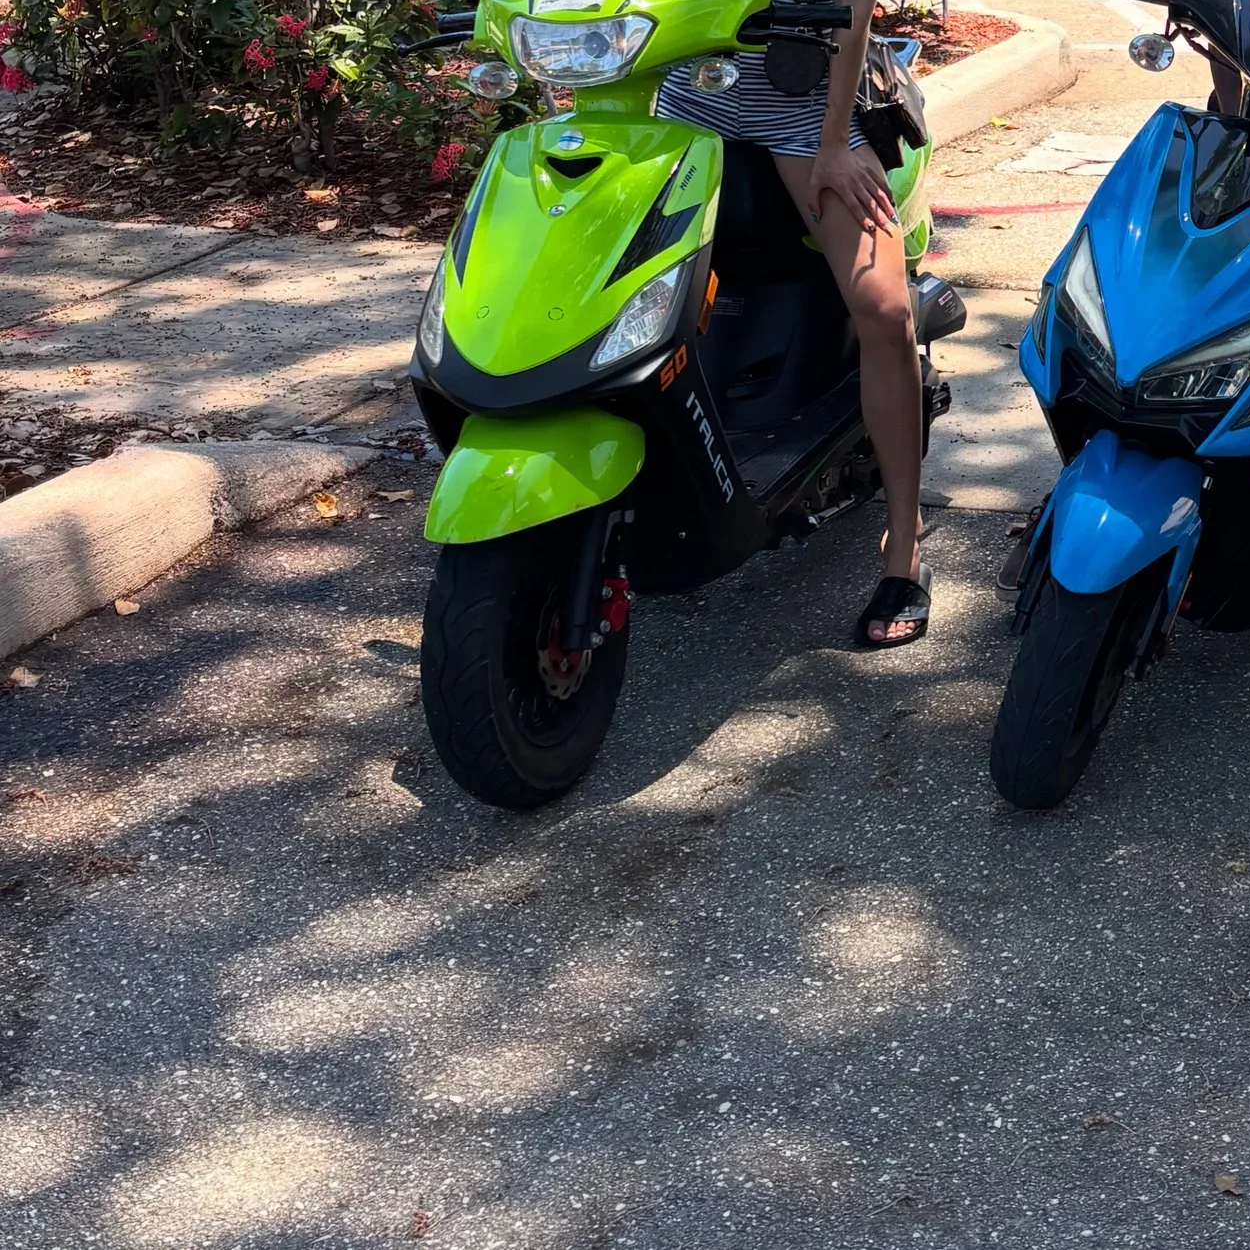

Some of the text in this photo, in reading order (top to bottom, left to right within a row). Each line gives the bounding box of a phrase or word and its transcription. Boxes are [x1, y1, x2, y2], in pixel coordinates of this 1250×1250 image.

[680, 165, 697, 191] MIAMI
[659, 343, 688, 392] 50
[685, 391, 735, 504] ITALICA
